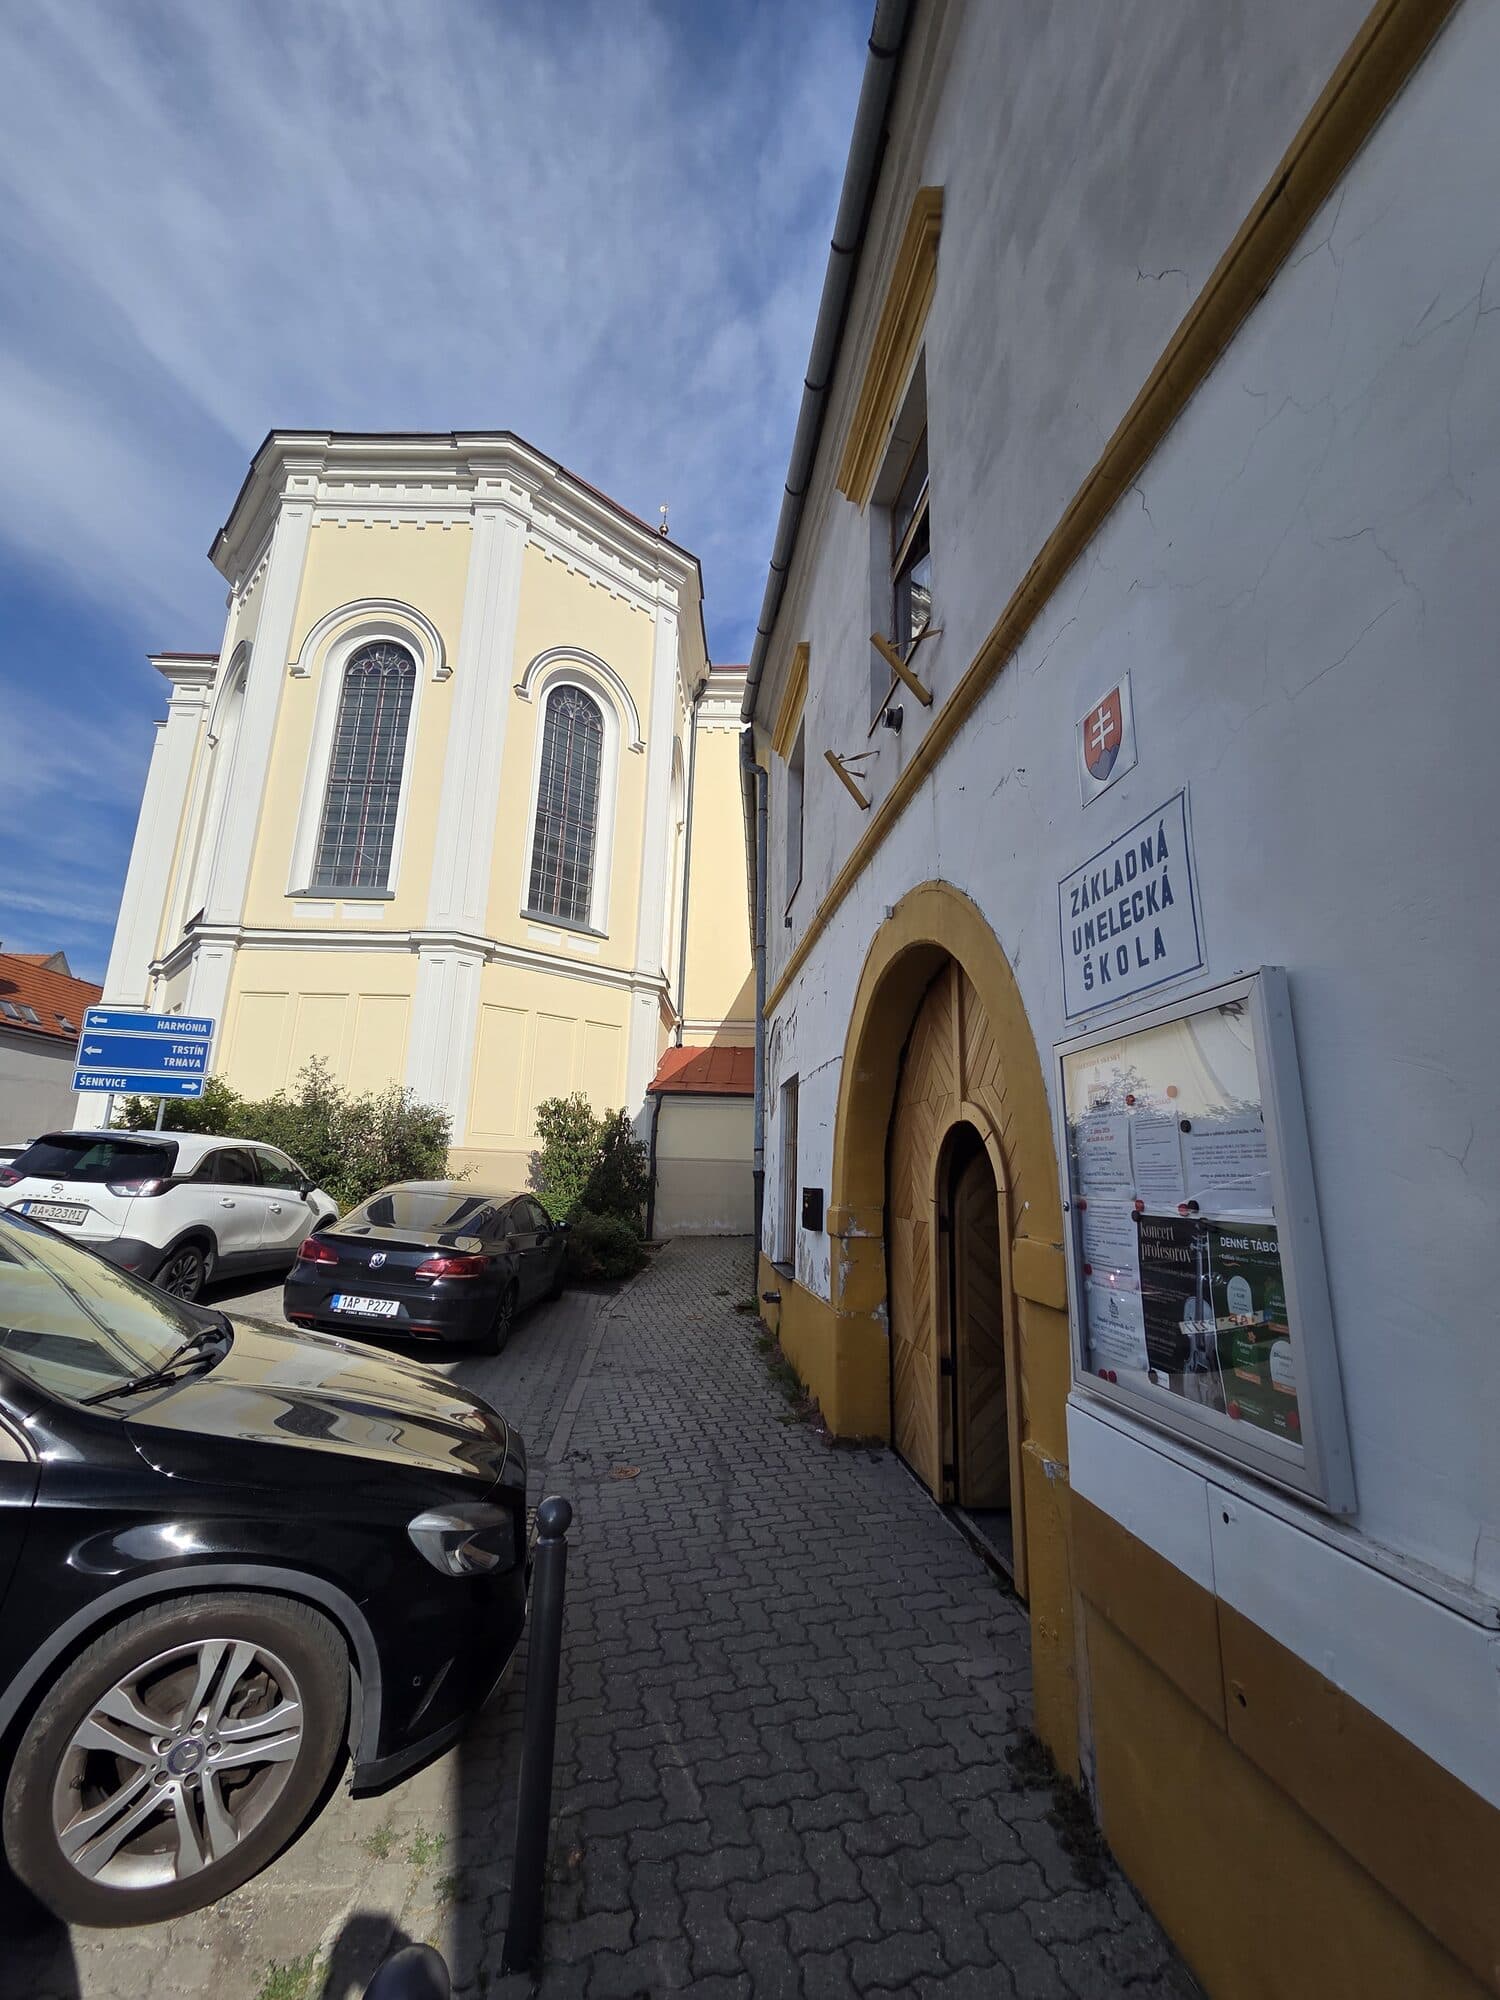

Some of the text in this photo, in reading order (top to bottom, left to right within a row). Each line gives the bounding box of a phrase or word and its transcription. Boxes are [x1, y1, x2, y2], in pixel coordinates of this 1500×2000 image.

[1069, 818, 1169, 918] ZÁKLADNÁ
[1072, 865, 1174, 956] UMELECKÁ
[1083, 926, 1167, 991] ŠKOLA
[157, 1020, 207, 1033] HARMÓNIA
[172, 1044, 204, 1056] TRSTÍN
[164, 1057, 201, 1068] TRNAVA
[79, 1074, 127, 1088] ŠENKVICE
[30, 1205, 45, 1216] AA
[1140, 1221, 1174, 1241] koncert
[1141, 1241, 1191, 1263] profesorov
[1220, 1236, 1280, 1252] DENNÉ TÁBO
[342, 1296, 394, 1313] 1AP P277
